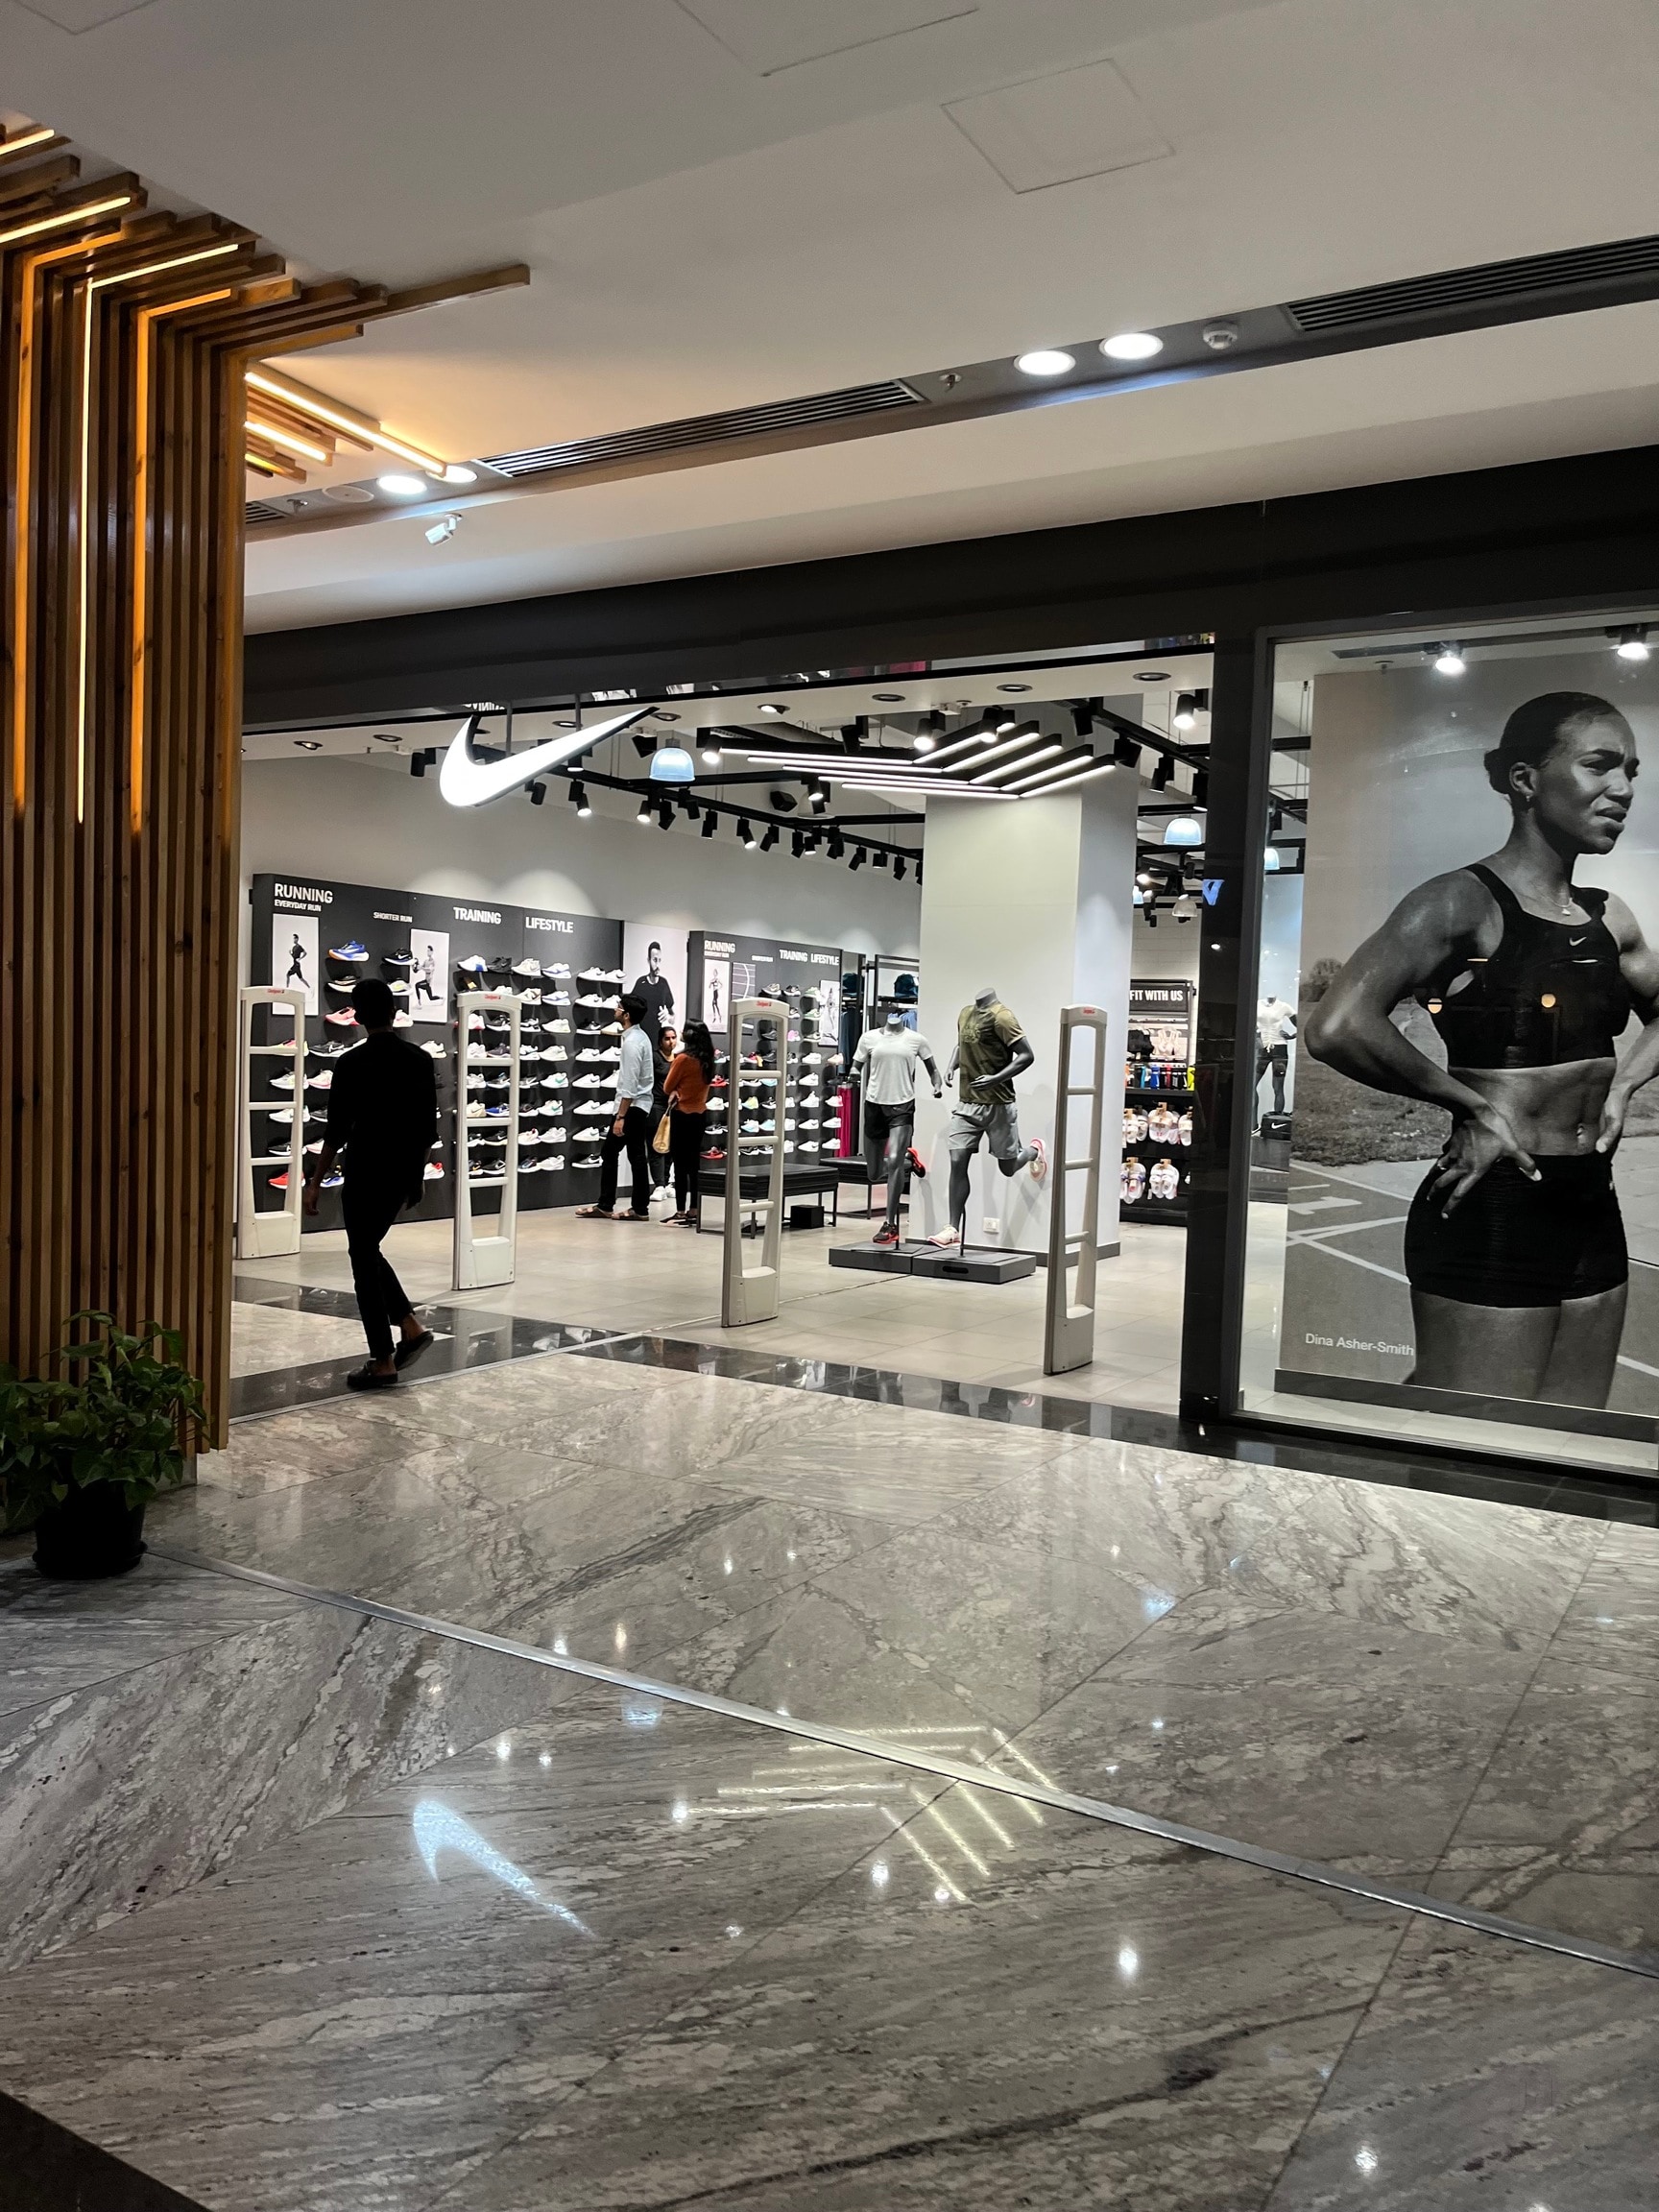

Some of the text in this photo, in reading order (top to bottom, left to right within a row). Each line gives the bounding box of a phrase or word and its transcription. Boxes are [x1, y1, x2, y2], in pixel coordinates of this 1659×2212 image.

[275, 882, 333, 904] RUNNING
[275, 899, 322, 912] EVERYDAY RUN
[453, 906, 502, 925] TRAINING
[525, 916, 574, 933] LIFESTYLE
[704, 940, 735, 953] RUNNING
[779, 950, 808, 963] TRAINING
[810, 953, 840, 966] LIFESTYLE
[1129, 990, 1183, 1001] FIT WITH US
[1305, 1333, 1414, 1357] Dina Asher-Smith
